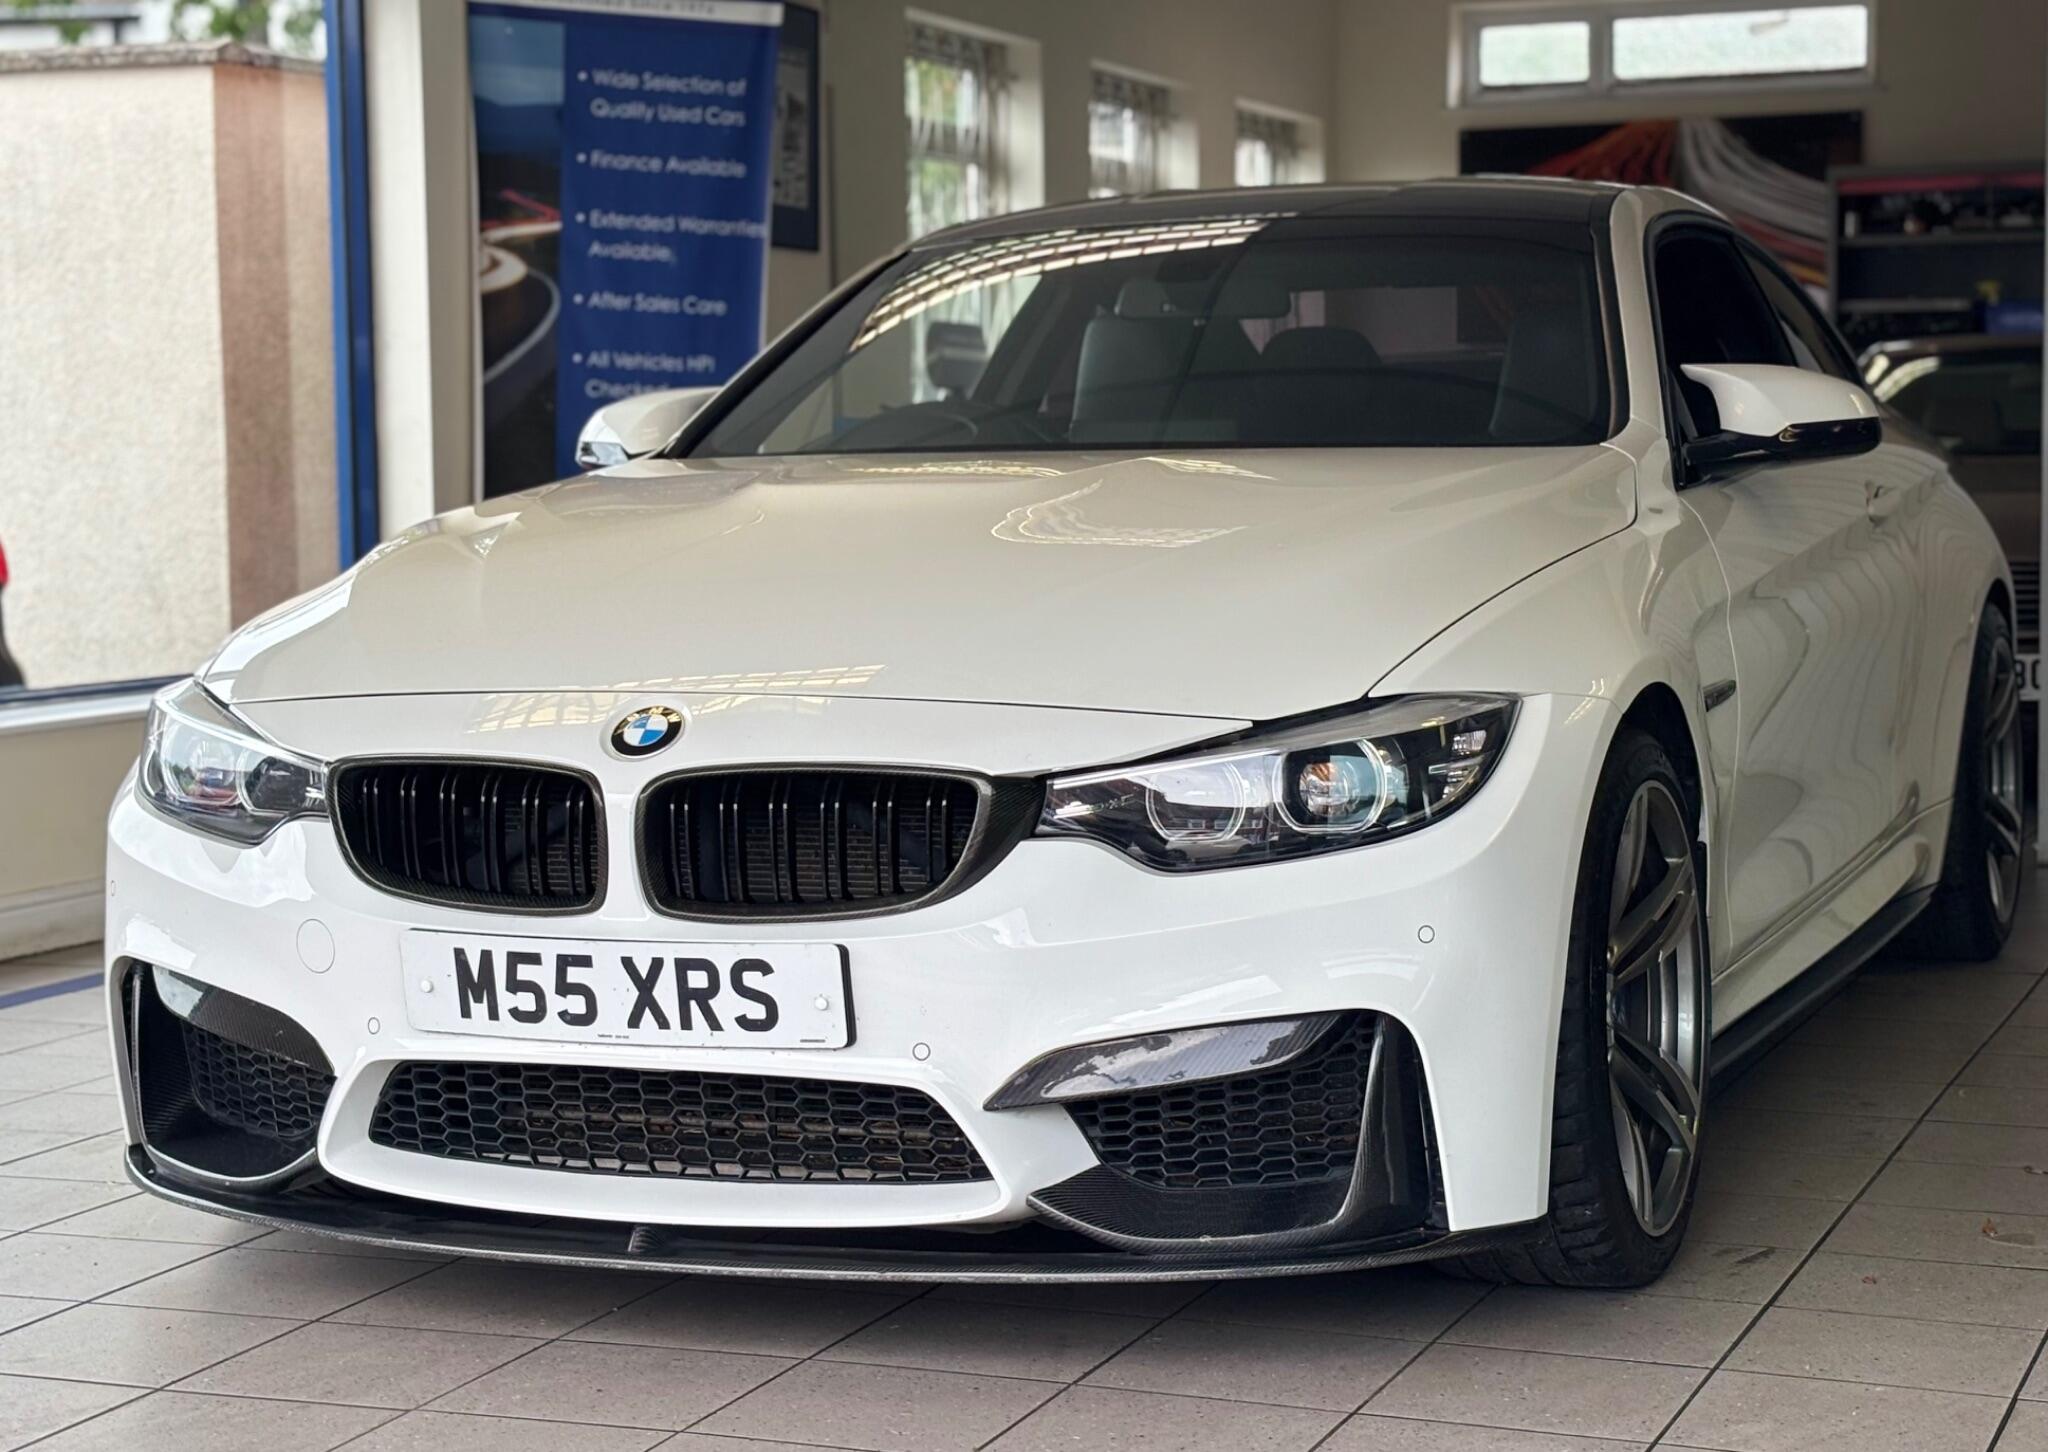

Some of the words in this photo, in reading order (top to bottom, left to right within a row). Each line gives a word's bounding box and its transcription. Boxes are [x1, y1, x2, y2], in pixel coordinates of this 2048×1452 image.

[592, 70, 640, 90] Wide
[641, 72, 724, 95] Selection
[726, 77, 748, 97] of
[590, 97, 655, 123] Quality
[657, 104, 704, 124] Used
[704, 105, 747, 127] Cars
[590, 150, 662, 172] Finance
[665, 156, 748, 178] Available
[589, 208, 676, 232] Extended
[588, 290, 632, 311] After
[634, 292, 680, 314] Sales
[682, 295, 728, 317] Care
[586, 350, 610, 369] All
[611, 351, 685, 373] Vehicles
[584, 378, 670, 400] Check
[453, 947, 598, 1027] M55
[620, 956, 779, 1032] XRS
